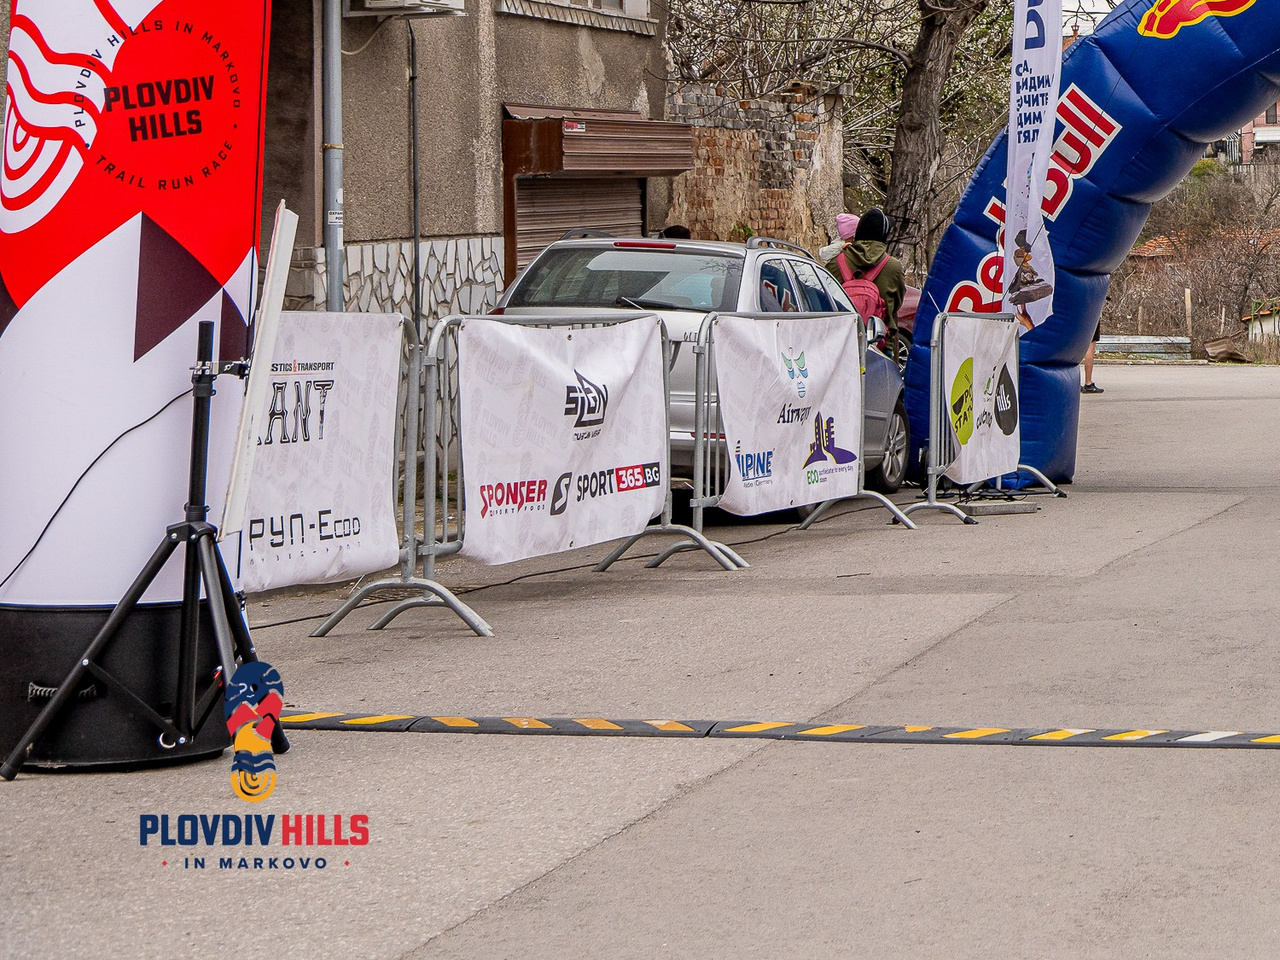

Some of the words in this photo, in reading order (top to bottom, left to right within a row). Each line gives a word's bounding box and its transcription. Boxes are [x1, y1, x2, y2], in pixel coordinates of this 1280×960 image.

[74, 49, 102, 128] PLOVDIV
[107, 20, 163, 47] HILLS
[175, 21, 193, 34] IN
[201, 32, 241, 108] MARKOVO
[104, 75, 214, 112] PLOVDIV
[129, 109, 202, 142] HILLS
[96, 154, 145, 189] TRAIL
[158, 175, 194, 190] RUN
[201, 140, 233, 177] RACE
[257, 379, 335, 445] ANT
[807, 469, 819, 485] ECO
[480, 480, 547, 519] SPONSER
